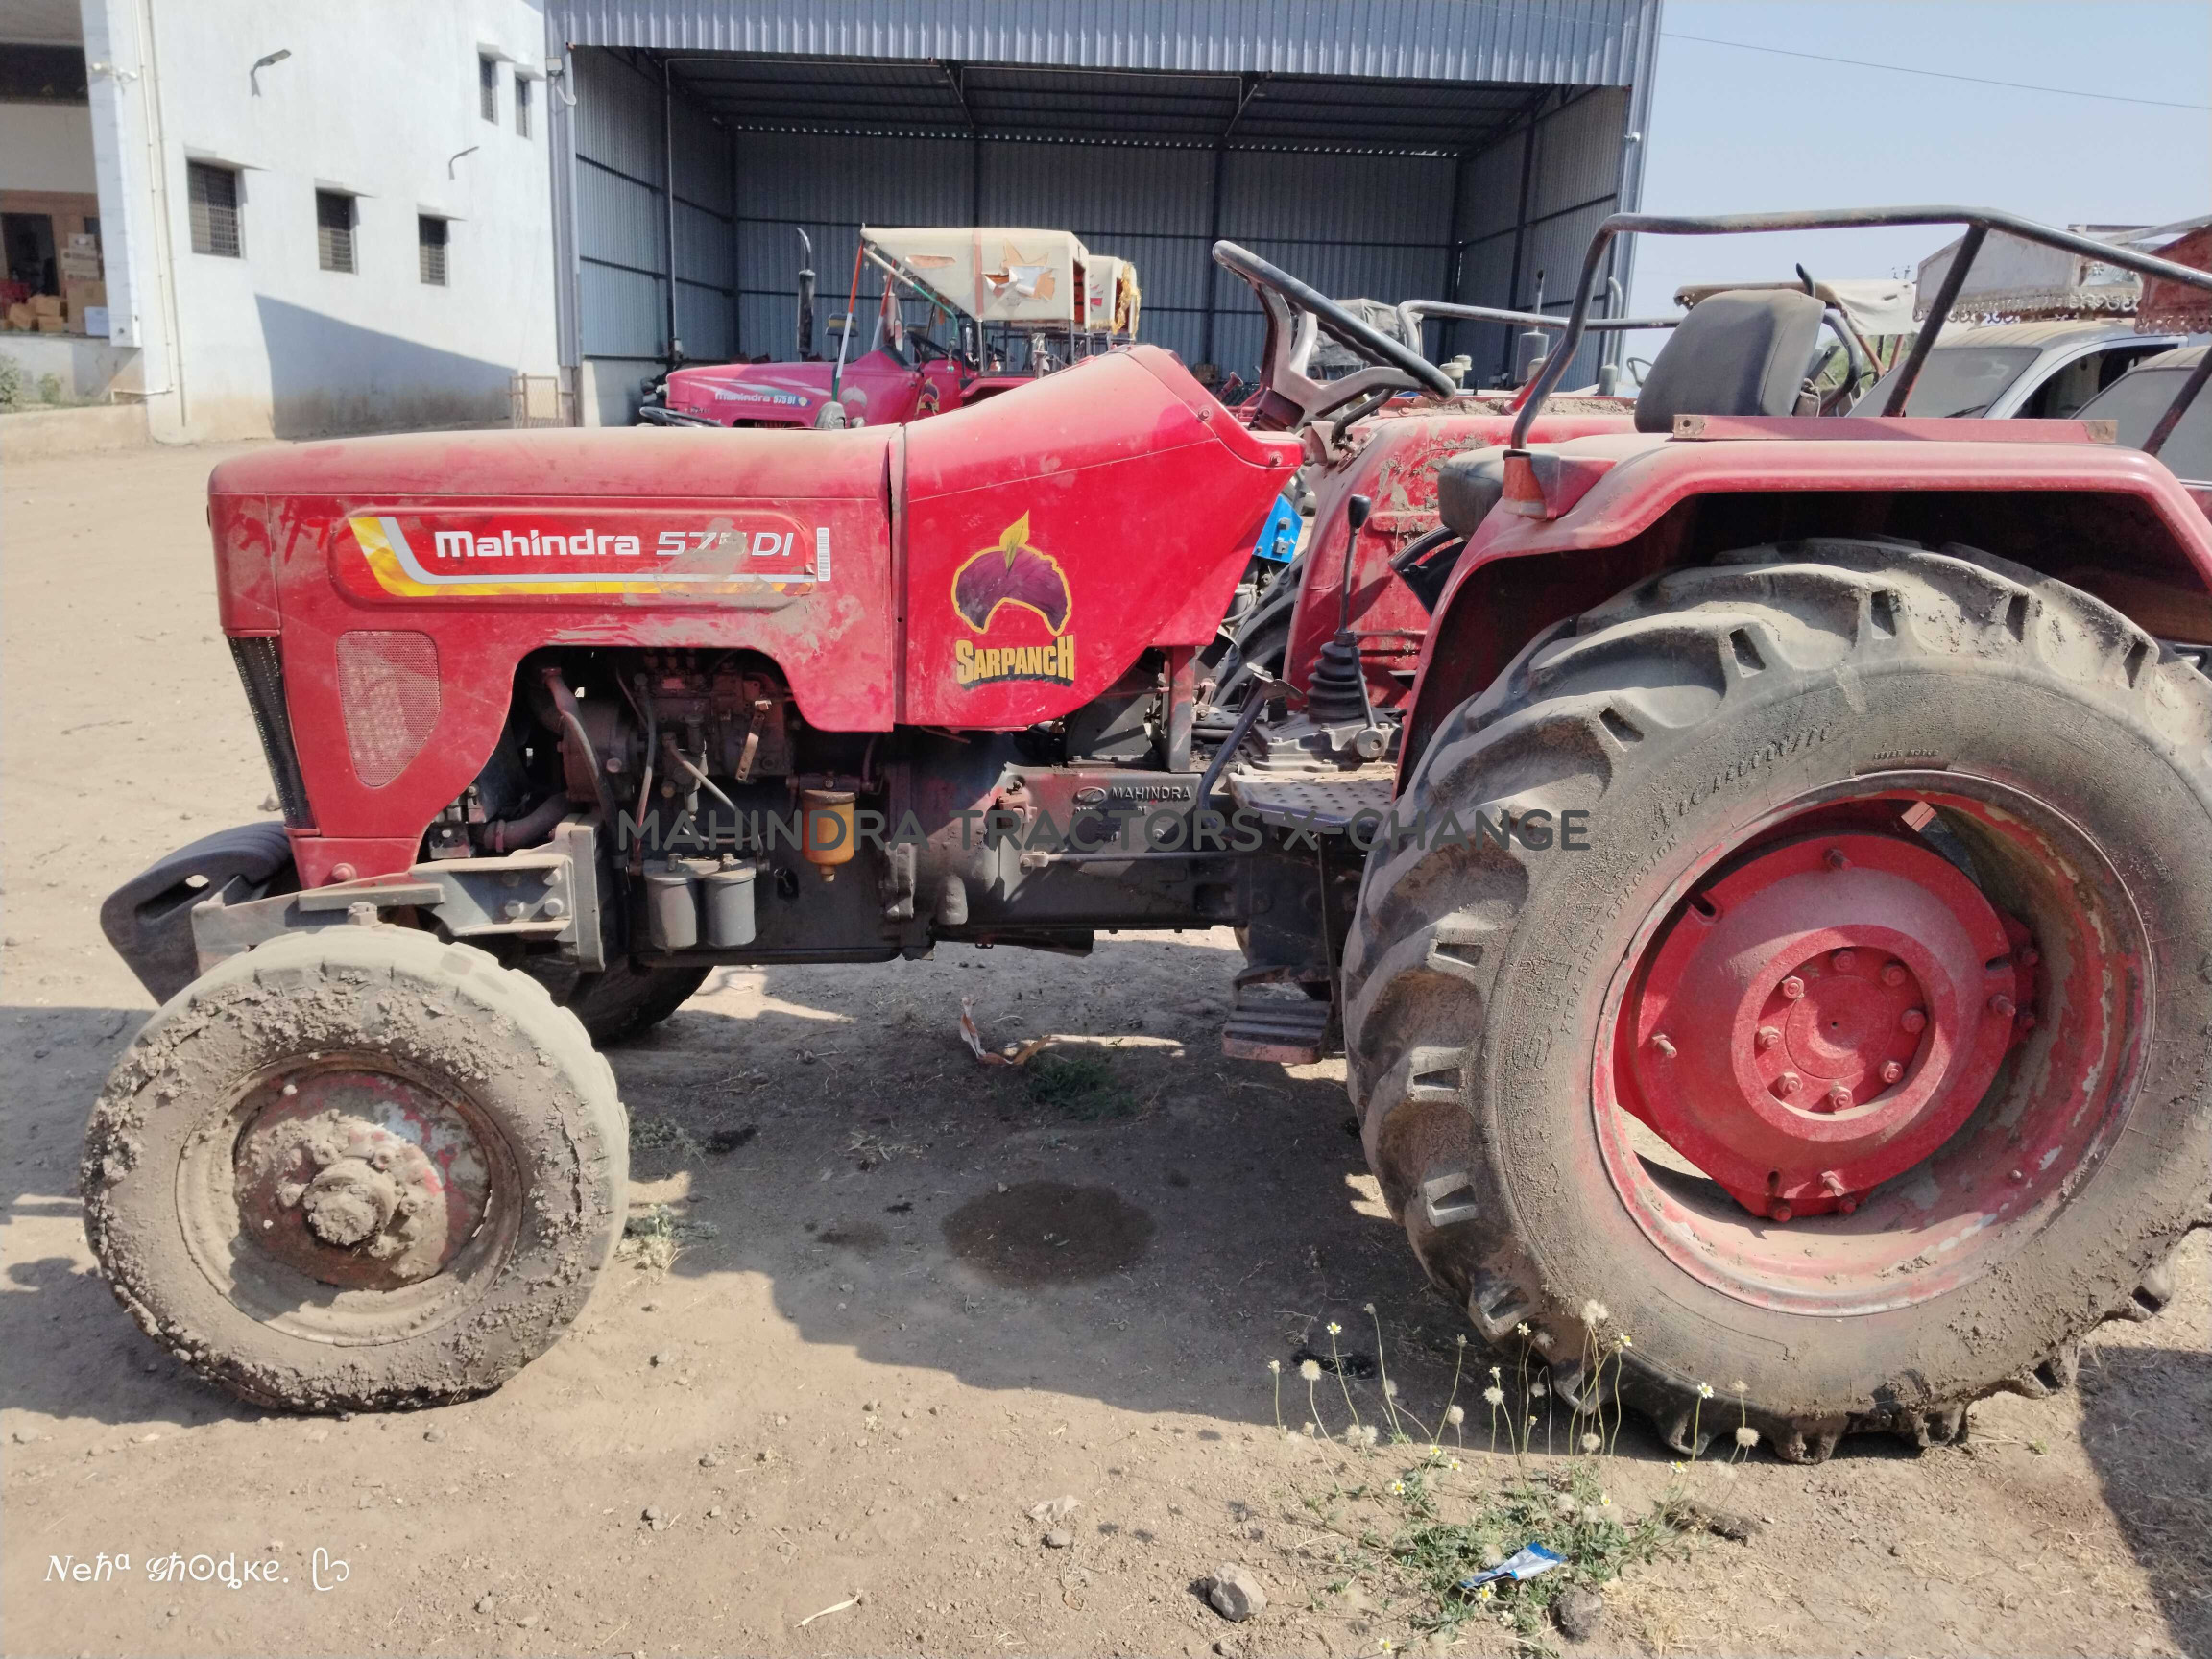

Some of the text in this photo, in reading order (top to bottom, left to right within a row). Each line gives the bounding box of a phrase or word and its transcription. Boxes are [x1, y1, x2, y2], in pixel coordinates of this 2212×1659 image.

[435, 529, 794, 558] Mahindra 57 DI
[955, 634, 1075, 688] SARPANCH
[1112, 785, 1191, 801] MAHINDRA
